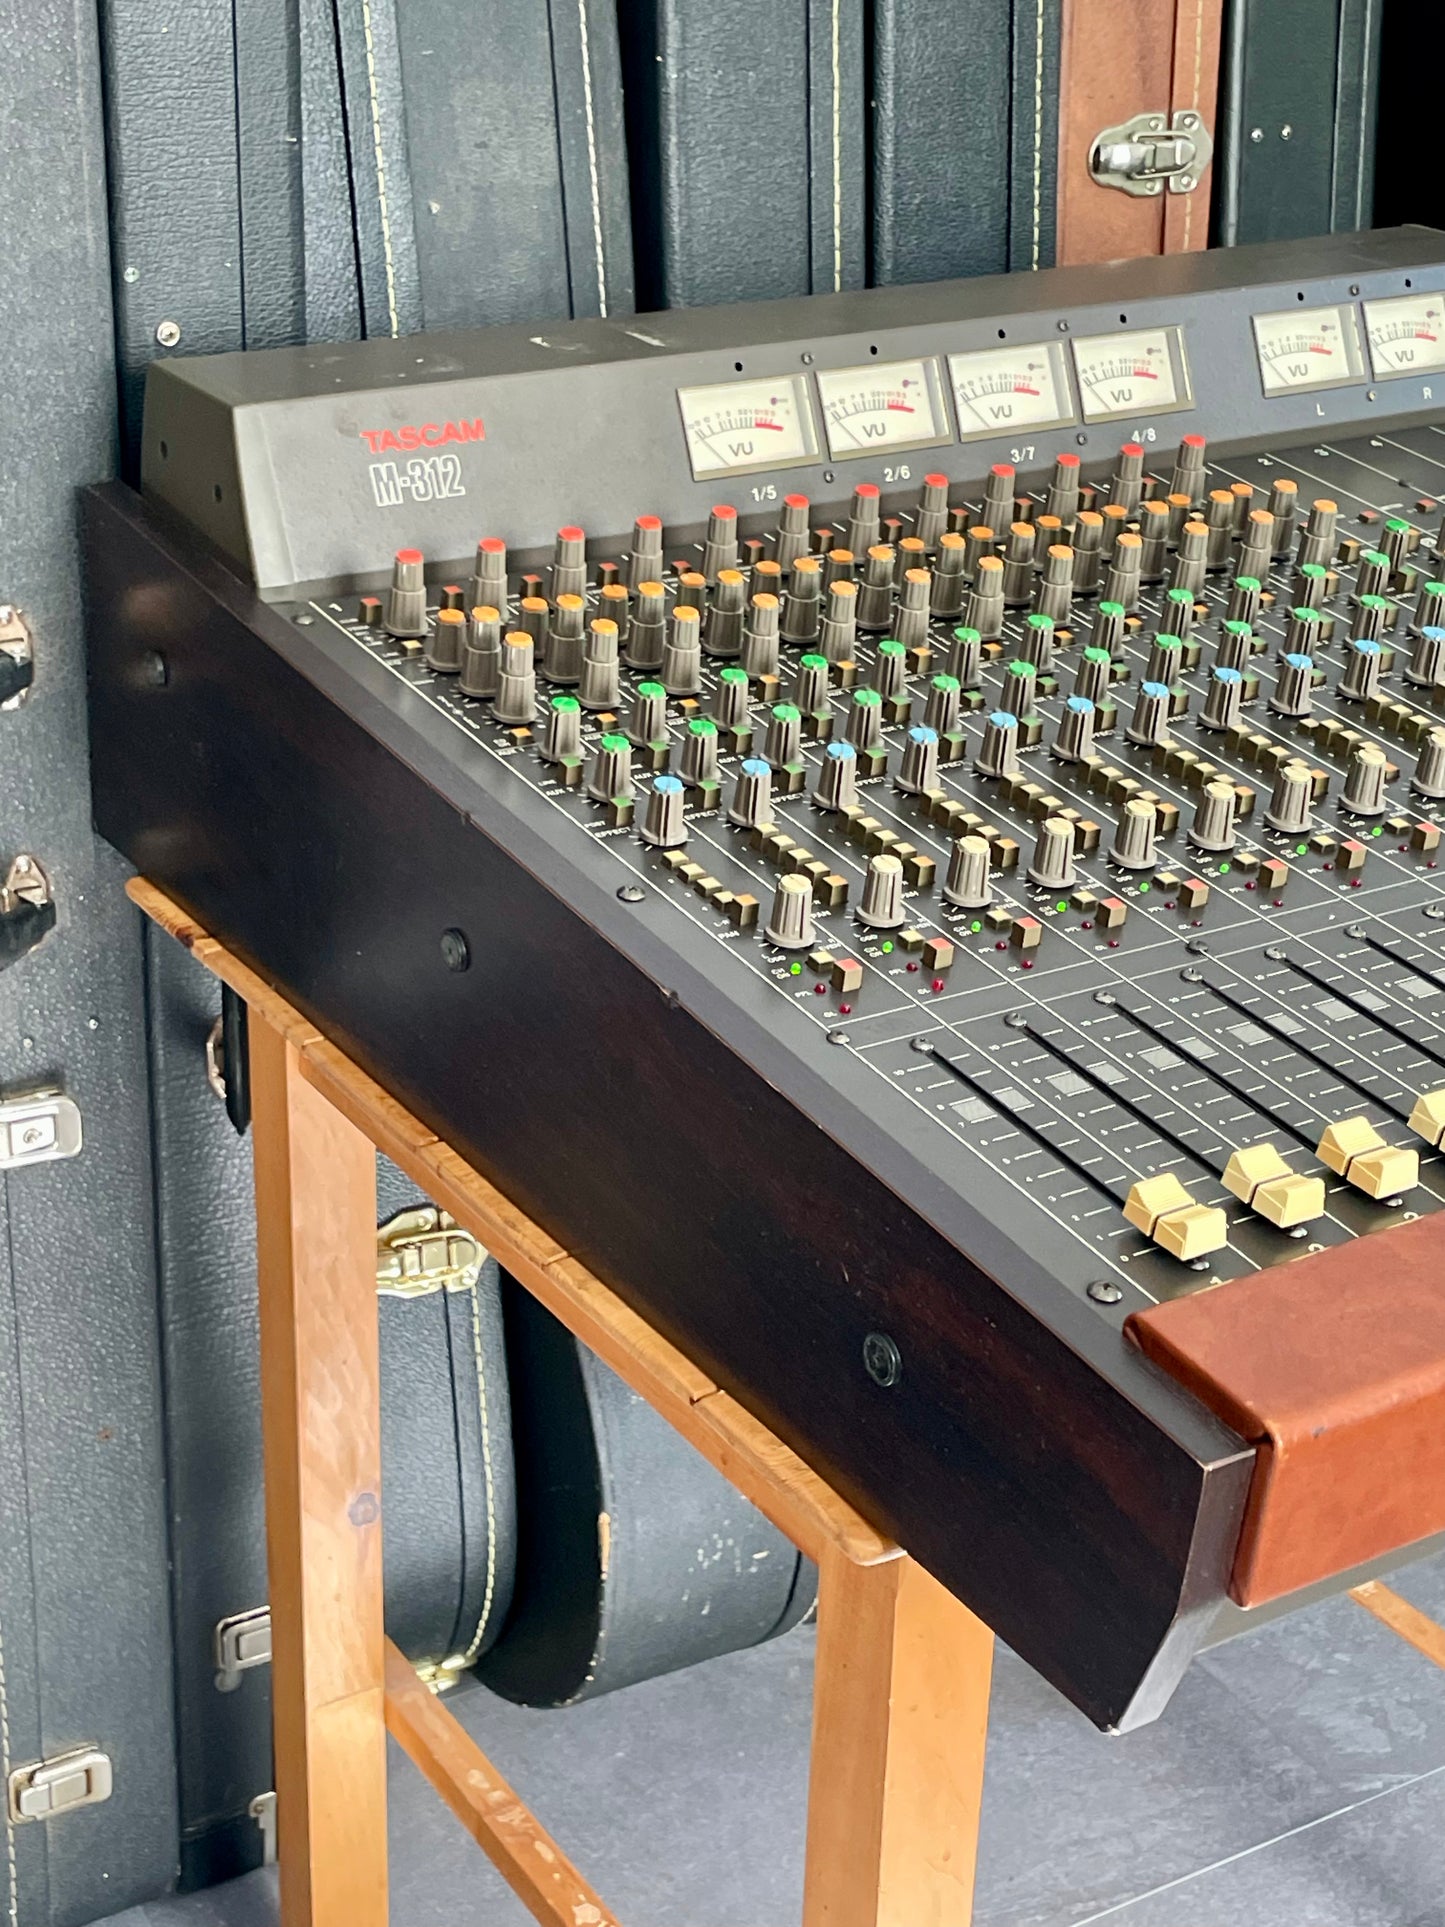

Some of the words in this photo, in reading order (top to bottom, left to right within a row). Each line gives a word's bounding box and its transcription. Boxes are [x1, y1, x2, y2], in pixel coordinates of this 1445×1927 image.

[1395, 350, 1415, 363] VU
[1288, 363, 1309, 377] VU
[1110, 389, 1133, 404] VU
[1422, 386, 1433, 400] R
[989, 404, 1013, 419] VU
[1316, 403, 1326, 416] L
[359, 418, 486, 454] TASCAM
[862, 422, 887, 438] VU
[1131, 428, 1157, 444] 4/8
[727, 440, 754, 457] VU
[1010, 446, 1035, 463] 3/7
[369, 454, 466, 507] M-312
[883, 465, 911, 483] 2/6
[751, 485, 777, 502] 1/5
